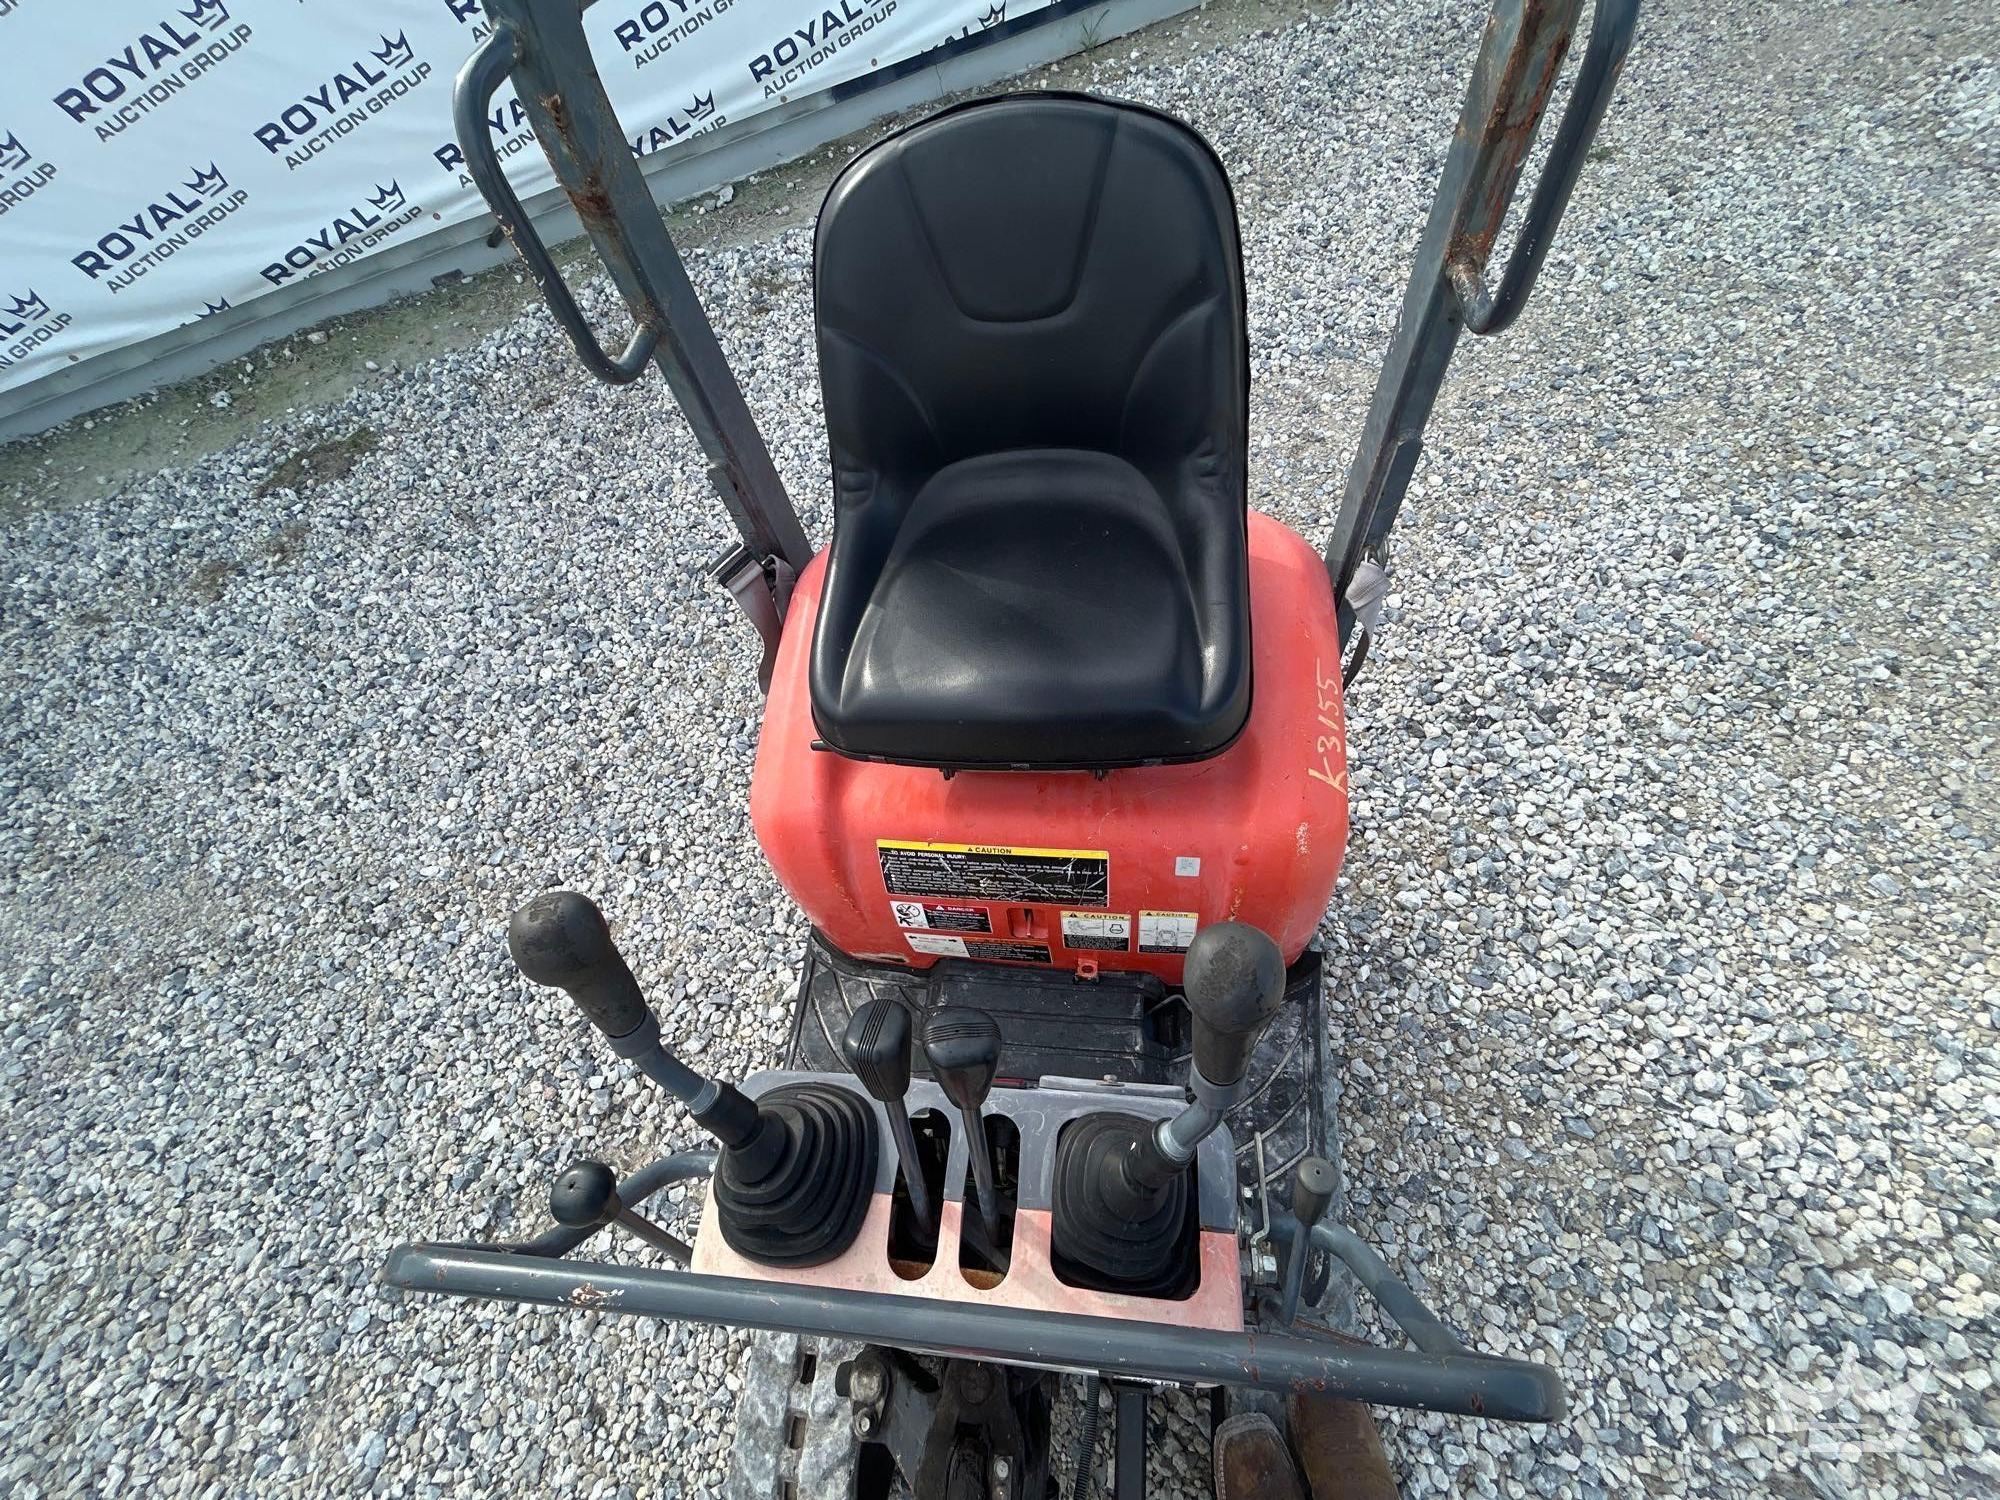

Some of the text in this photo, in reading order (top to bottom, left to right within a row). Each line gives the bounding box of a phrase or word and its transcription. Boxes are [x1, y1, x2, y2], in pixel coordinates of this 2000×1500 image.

[613, 0, 704, 51] ROY
[633, 7, 713, 69] AUCTION
[748, 0, 864, 83] ROYAL
[763, 42, 837, 99] AUCTION
[838, 1, 898, 47] GROUP
[53, 21, 202, 124] ROYAL
[94, 23, 253, 142] AUCTION GROUP
[253, 61, 388, 155] ROYAL
[285, 61, 432, 171] AUCTION GROUP
[70, 192, 203, 279] ROYAL
[106, 189, 249, 294] AUCTION GROUP
[259, 207, 382, 286] ROYAL
[361, 206, 423, 248] GROUP
[8, 312, 73, 360] GROUP
[1308, 656, 1347, 796] K3155
[975, 847, 1012, 855] CAUTION
[1083, 913, 1125, 921] CAUTION
